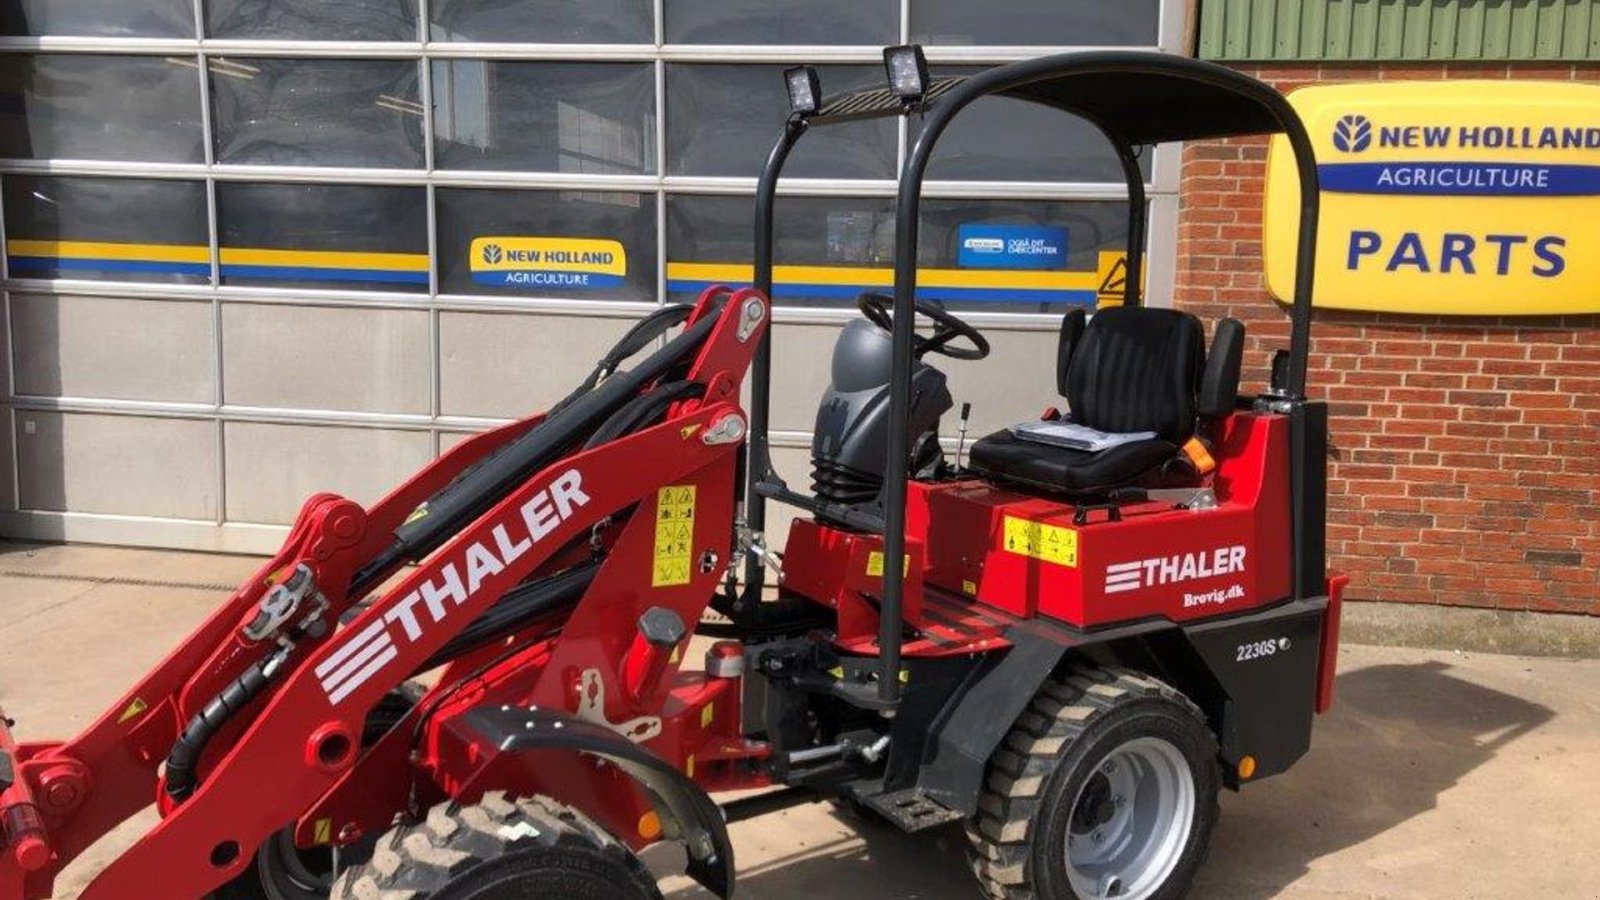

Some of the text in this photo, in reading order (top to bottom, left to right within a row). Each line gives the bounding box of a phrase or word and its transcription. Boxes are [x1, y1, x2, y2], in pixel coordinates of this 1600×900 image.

[1379, 126, 1600, 148] NEW HOLLAND
[1377, 167, 1549, 188] AGRICULTURE
[506, 250, 613, 265] NEW HOLLAND
[1346, 230, 1566, 278] PARTS
[505, 272, 589, 285] AGRICULTURE
[386, 468, 591, 642] THALER
[1141, 545, 1247, 586] THALER
[1183, 584, 1245, 608] Brovig.dk
[1236, 639, 1276, 662] 2230S
